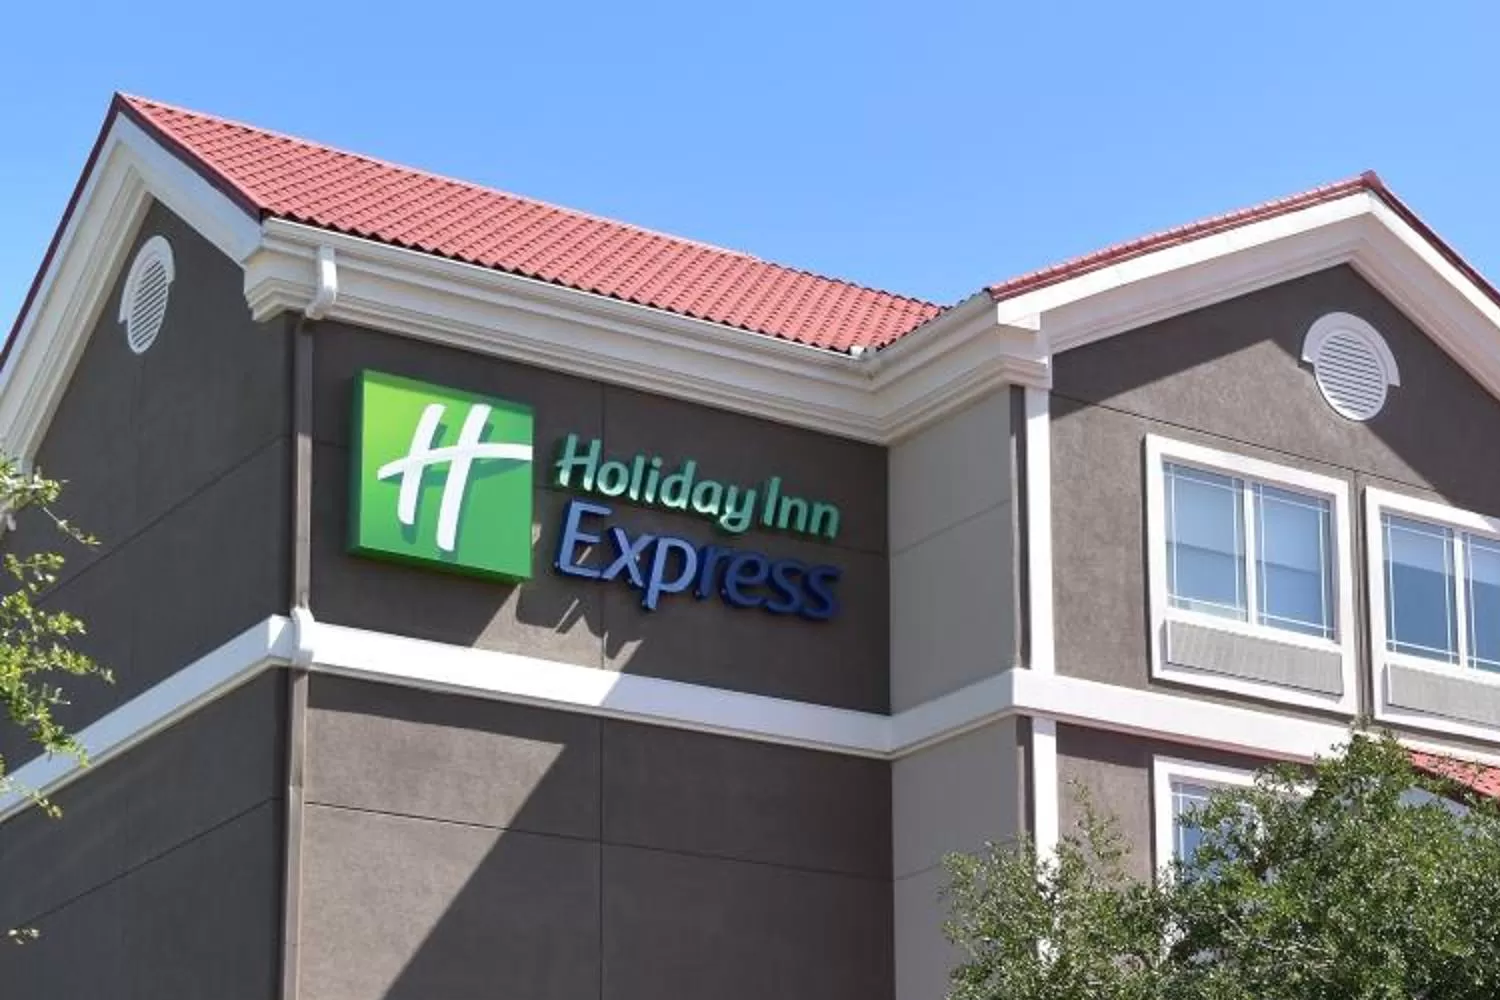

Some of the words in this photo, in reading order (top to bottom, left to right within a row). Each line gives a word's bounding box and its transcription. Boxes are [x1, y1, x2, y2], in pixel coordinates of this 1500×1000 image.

[555, 433, 757, 534] Holiday
[762, 475, 842, 540] Inn
[554, 498, 842, 621] Express
